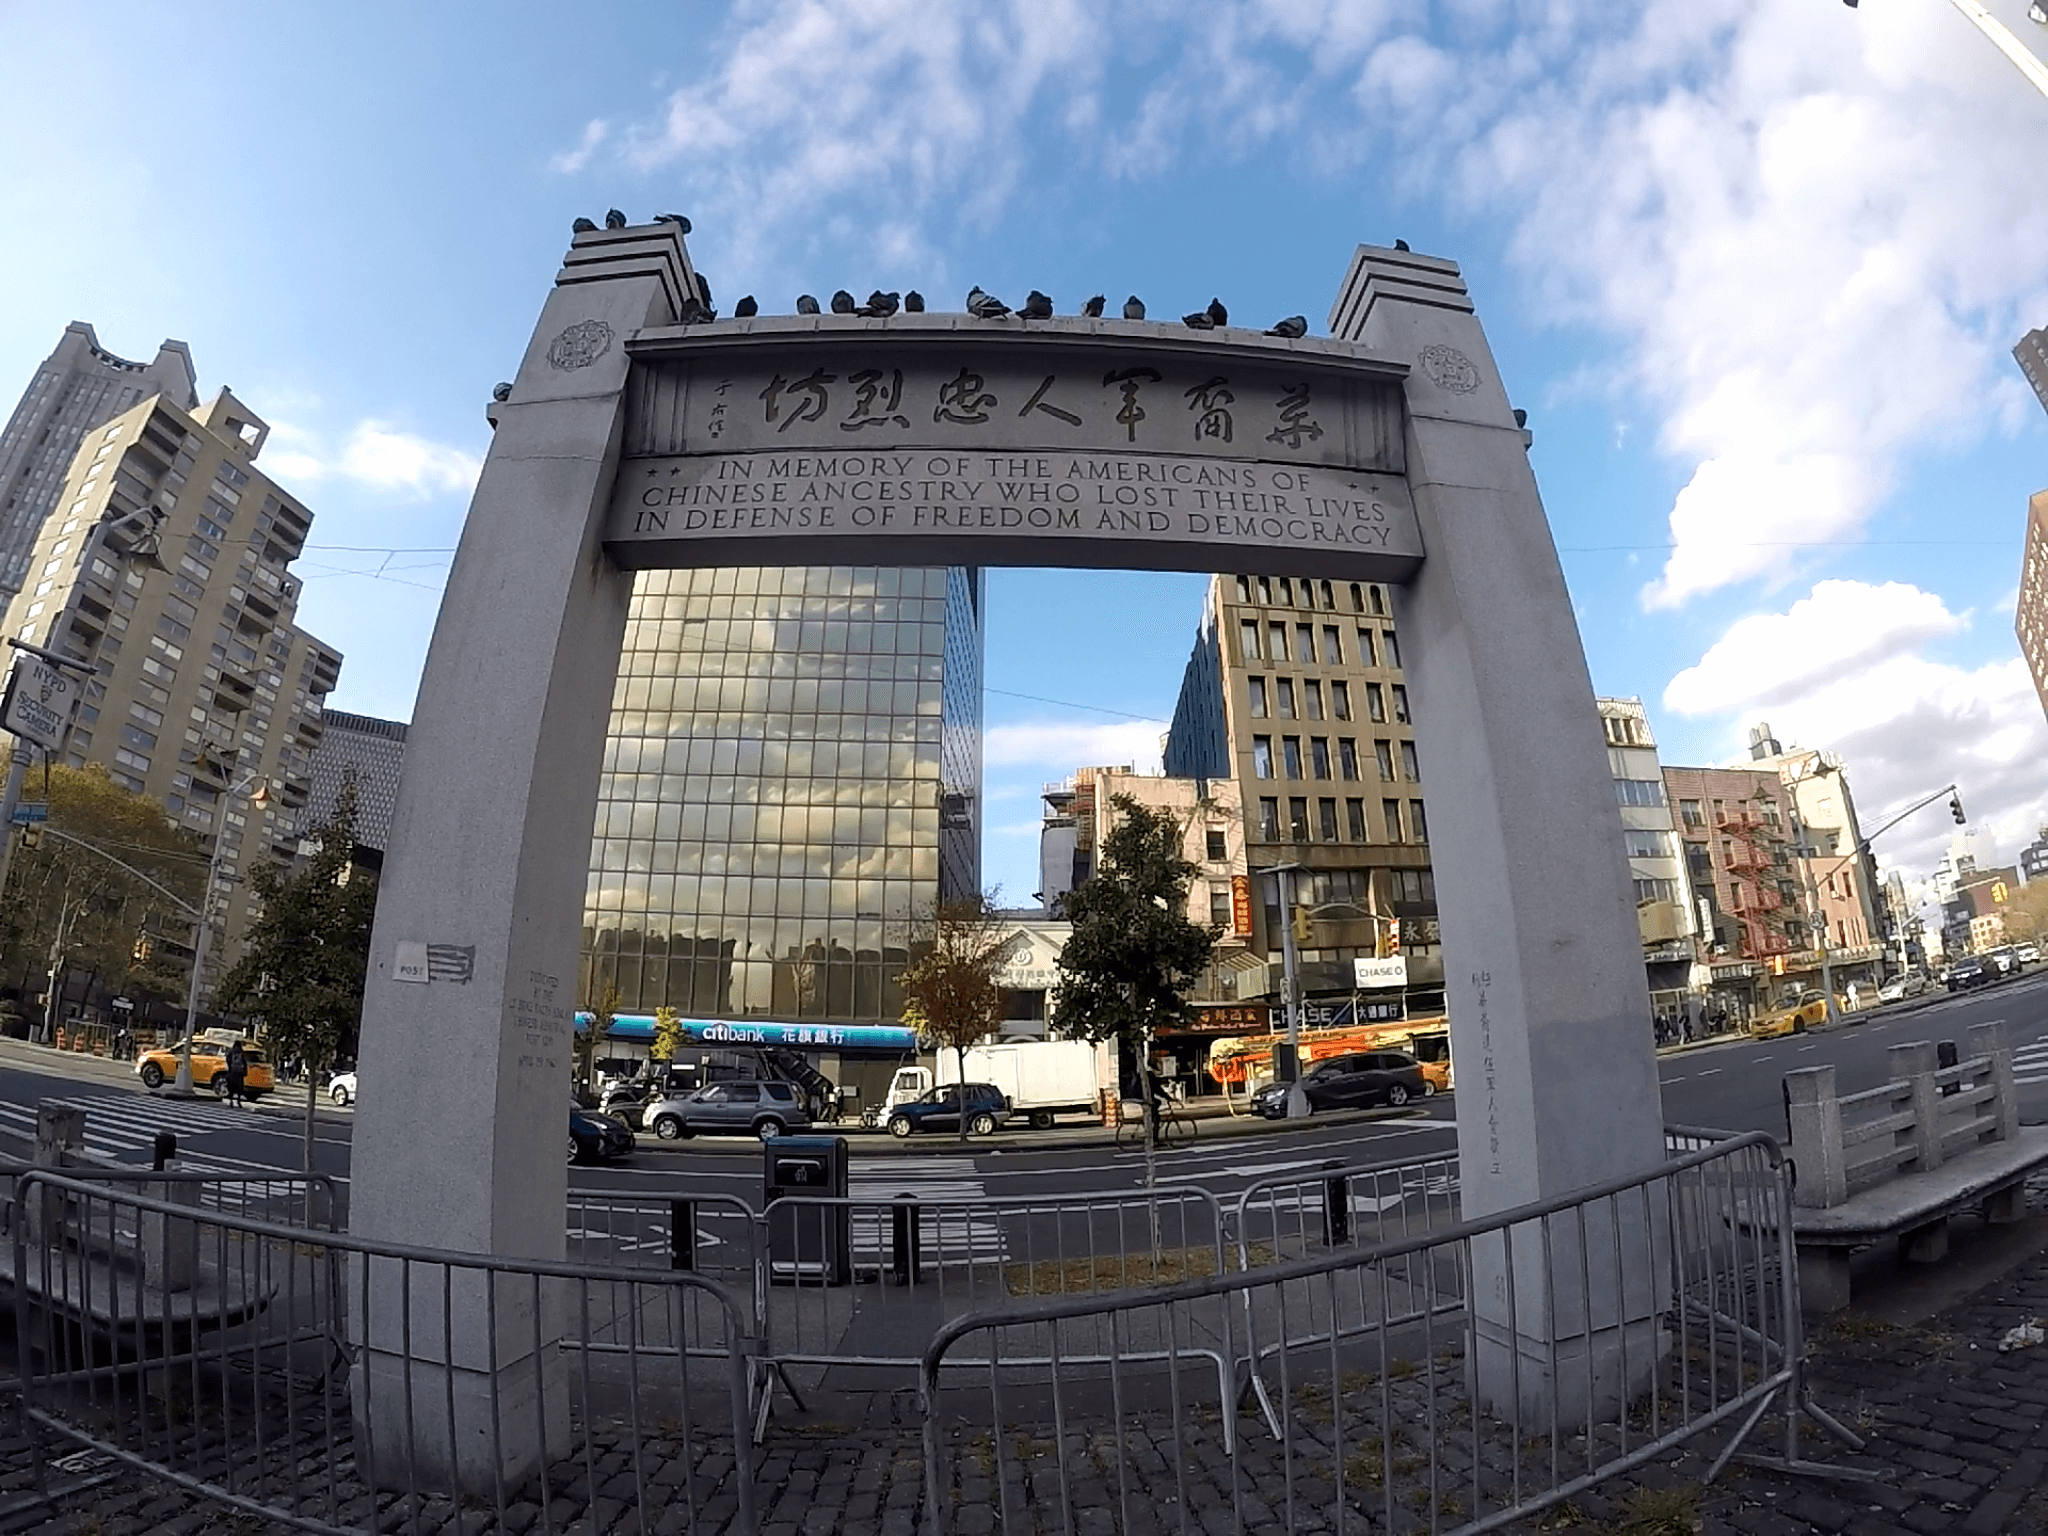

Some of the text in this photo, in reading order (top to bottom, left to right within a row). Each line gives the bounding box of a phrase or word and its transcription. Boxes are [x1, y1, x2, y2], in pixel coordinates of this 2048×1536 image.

[717, 456, 1310, 492] IN MEMORY OF THE AMERICANS OF
[642, 480, 1387, 523] CHINESE ANCESTRY WHO LOST THEIR LIVES
[632, 506, 1392, 547] IN DEFENSE OF FREEDOM AND DEMOCRACY
[33, 665, 67, 693] NYPD
[17, 690, 64, 726] SECURITY
[17, 705, 57, 738] CAMERA
[1359, 966, 1393, 978] CHASE
[702, 1023, 765, 1043] citibank
